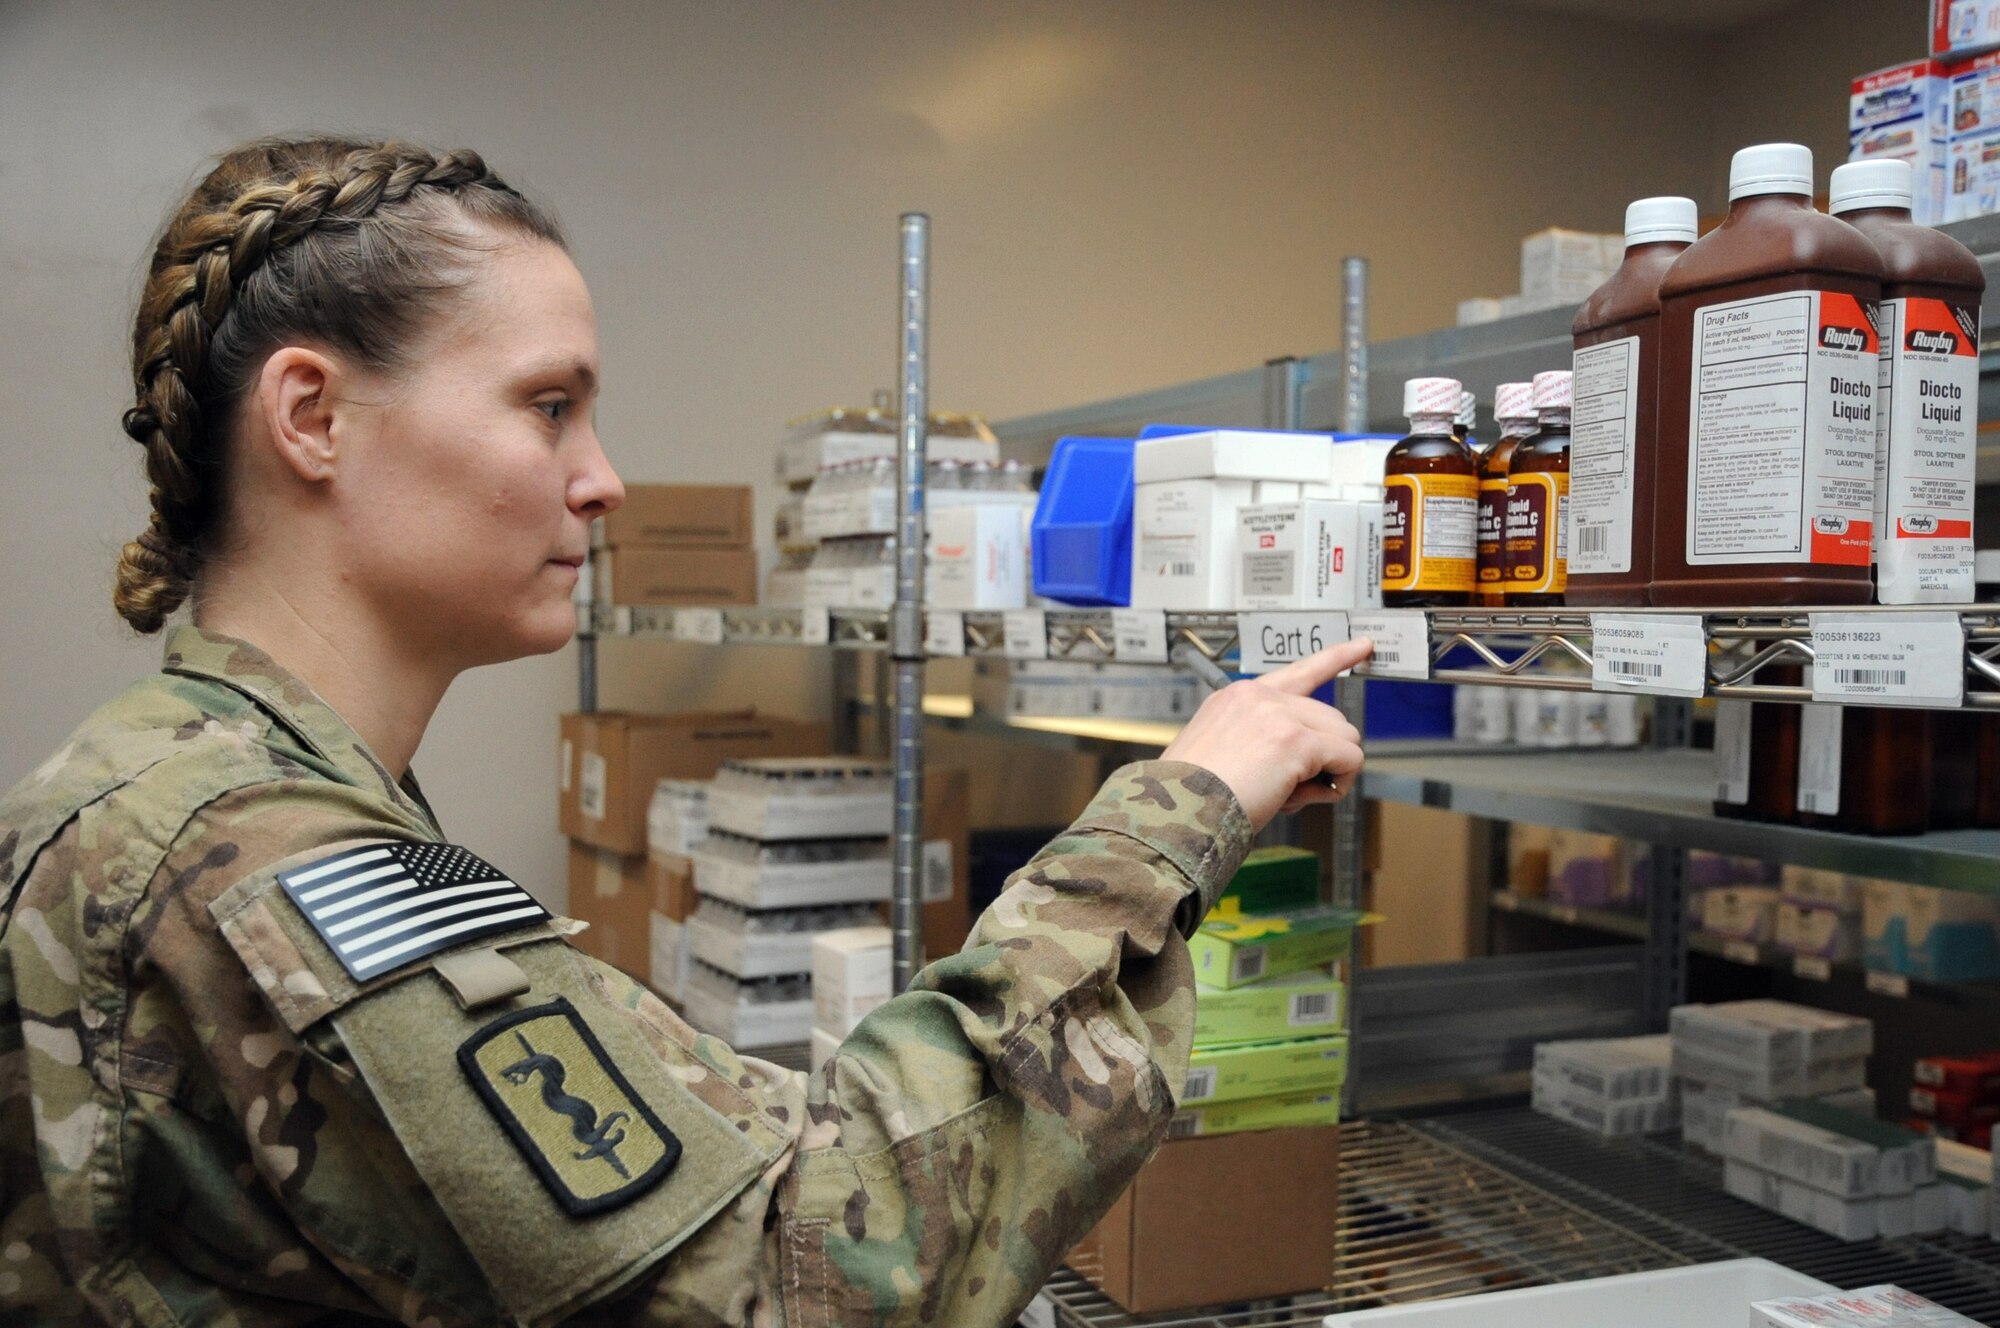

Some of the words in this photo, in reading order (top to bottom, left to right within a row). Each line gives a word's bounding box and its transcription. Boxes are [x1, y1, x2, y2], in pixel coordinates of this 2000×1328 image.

[1706, 316, 1725, 326] Drug
[1726, 311, 1749, 322] Facts
[1722, 326, 1751, 336] ingredient
[1824, 327, 1863, 351] Rugby
[1913, 330, 1953, 354] Rugby
[1830, 376, 1871, 398] Diocto
[1920, 380, 1962, 399] Diocto
[1832, 400, 1871, 423] Liquid
[1922, 403, 1961, 424] Liquid
[1828, 425, 1854, 434] Docusate
[1854, 428, 1874, 436] Sodium
[1917, 427, 1943, 435] Docusate
[1847, 450, 1874, 459] SOFTENER
[1837, 460, 1864, 468] LAXATIVE
[1508, 499, 1530, 514] Liquid
[1398, 512, 1406, 525] C
[1494, 517, 1501, 529] C
[1530, 512, 1538, 525] C
[1820, 517, 1842, 530] Rugby
[1910, 516, 1932, 529] Rugby
[1595, 628, 1644, 639] F00536059085
[1815, 632, 1880, 642] F00536136223
[1261, 625, 1304, 657] Cart
[1310, 625, 1322, 654] 6
